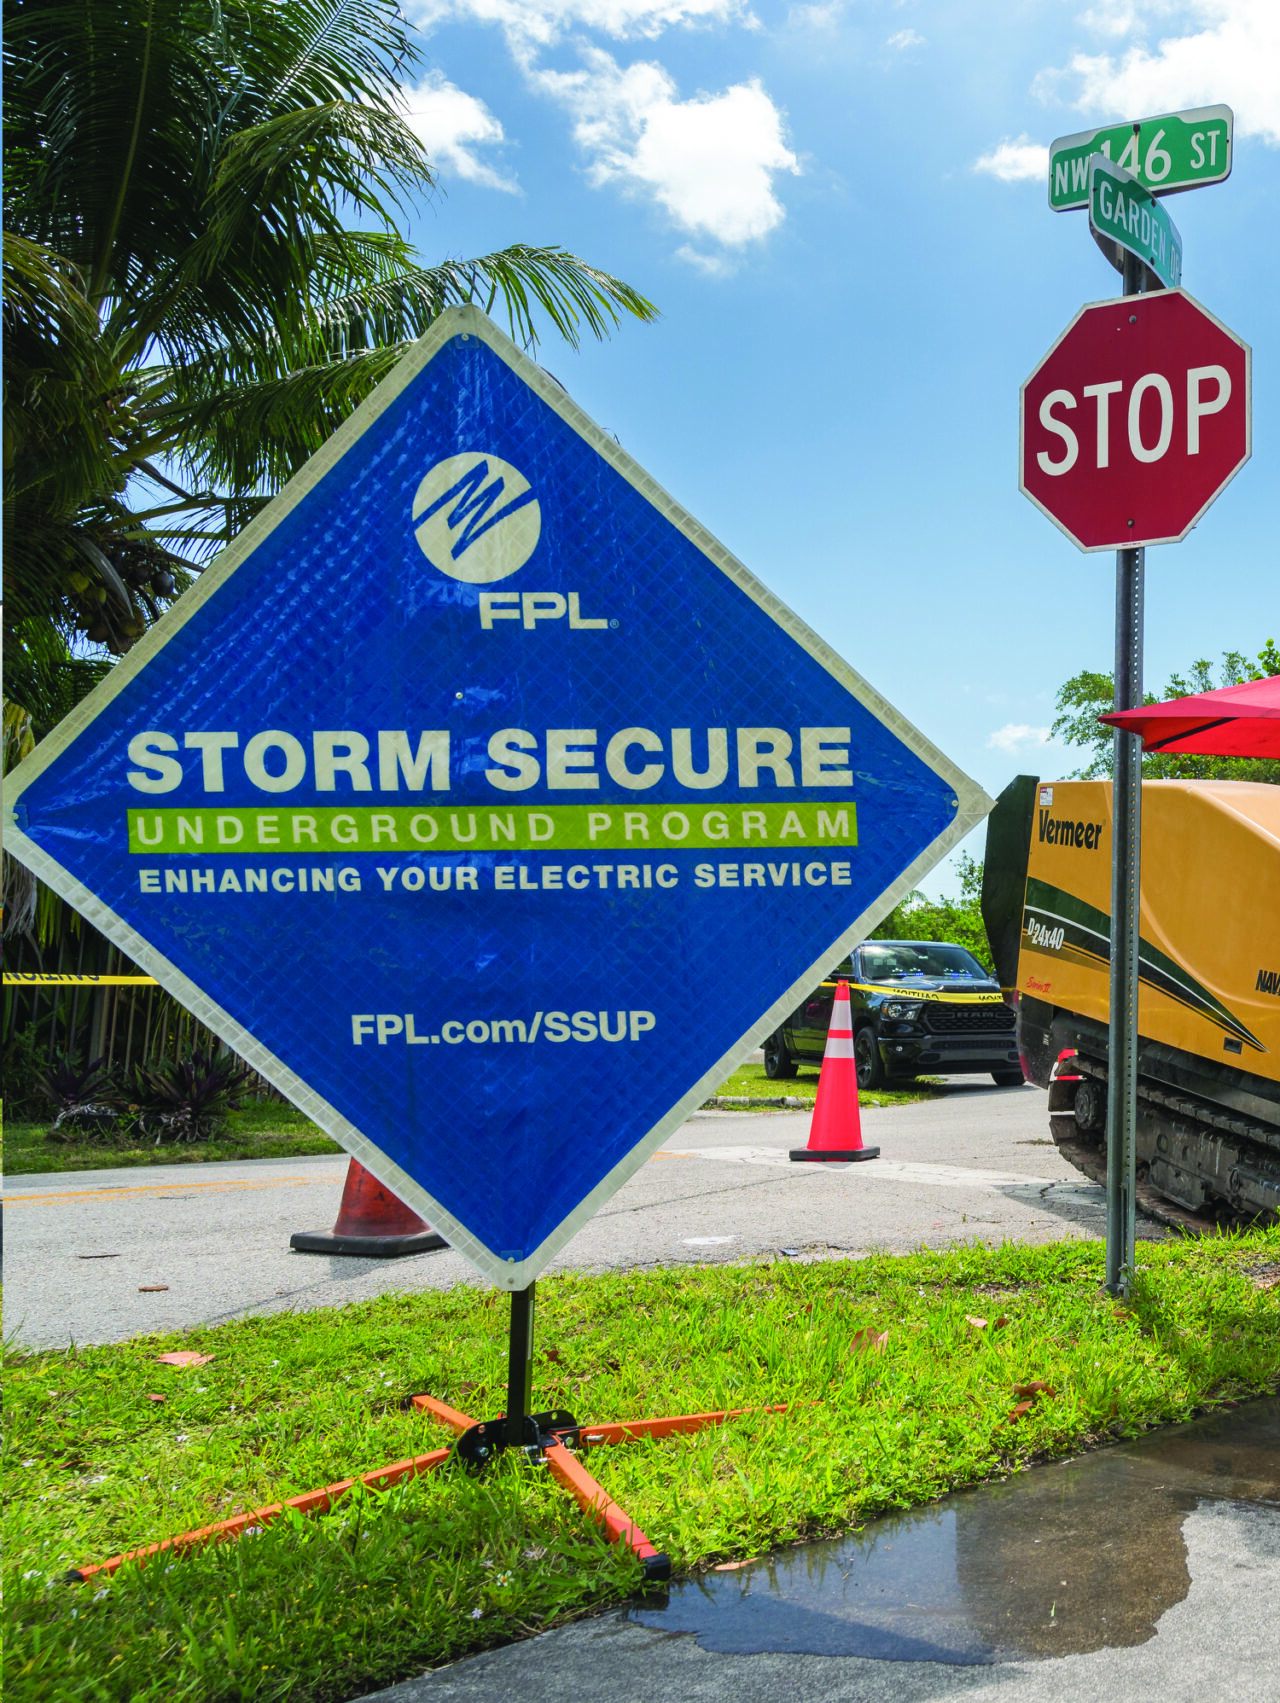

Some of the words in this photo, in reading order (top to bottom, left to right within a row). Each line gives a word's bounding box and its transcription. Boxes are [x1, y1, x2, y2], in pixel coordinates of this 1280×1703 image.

[1054, 156, 1090, 197] NW
[1190, 129, 1221, 170] ST
[1099, 180, 1167, 266] GARDEN
[1036, 364, 1232, 477] STOP
[479, 592, 609, 630] FPL
[127, 730, 451, 794] STORM
[484, 727, 854, 792] SECURE
[137, 813, 555, 846] UNDERGROUND
[587, 810, 852, 842] PROGRAM
[1039, 809, 1102, 850] Vermeer
[139, 867, 362, 893] ENHANCING
[376, 865, 479, 892] YOUR
[494, 863, 679, 891] ELECTRIC
[693, 862, 853, 888] SERVICE
[351, 1010, 657, 1046] FPL.com/SSUP
[957, 1011, 994, 1019] RAM
